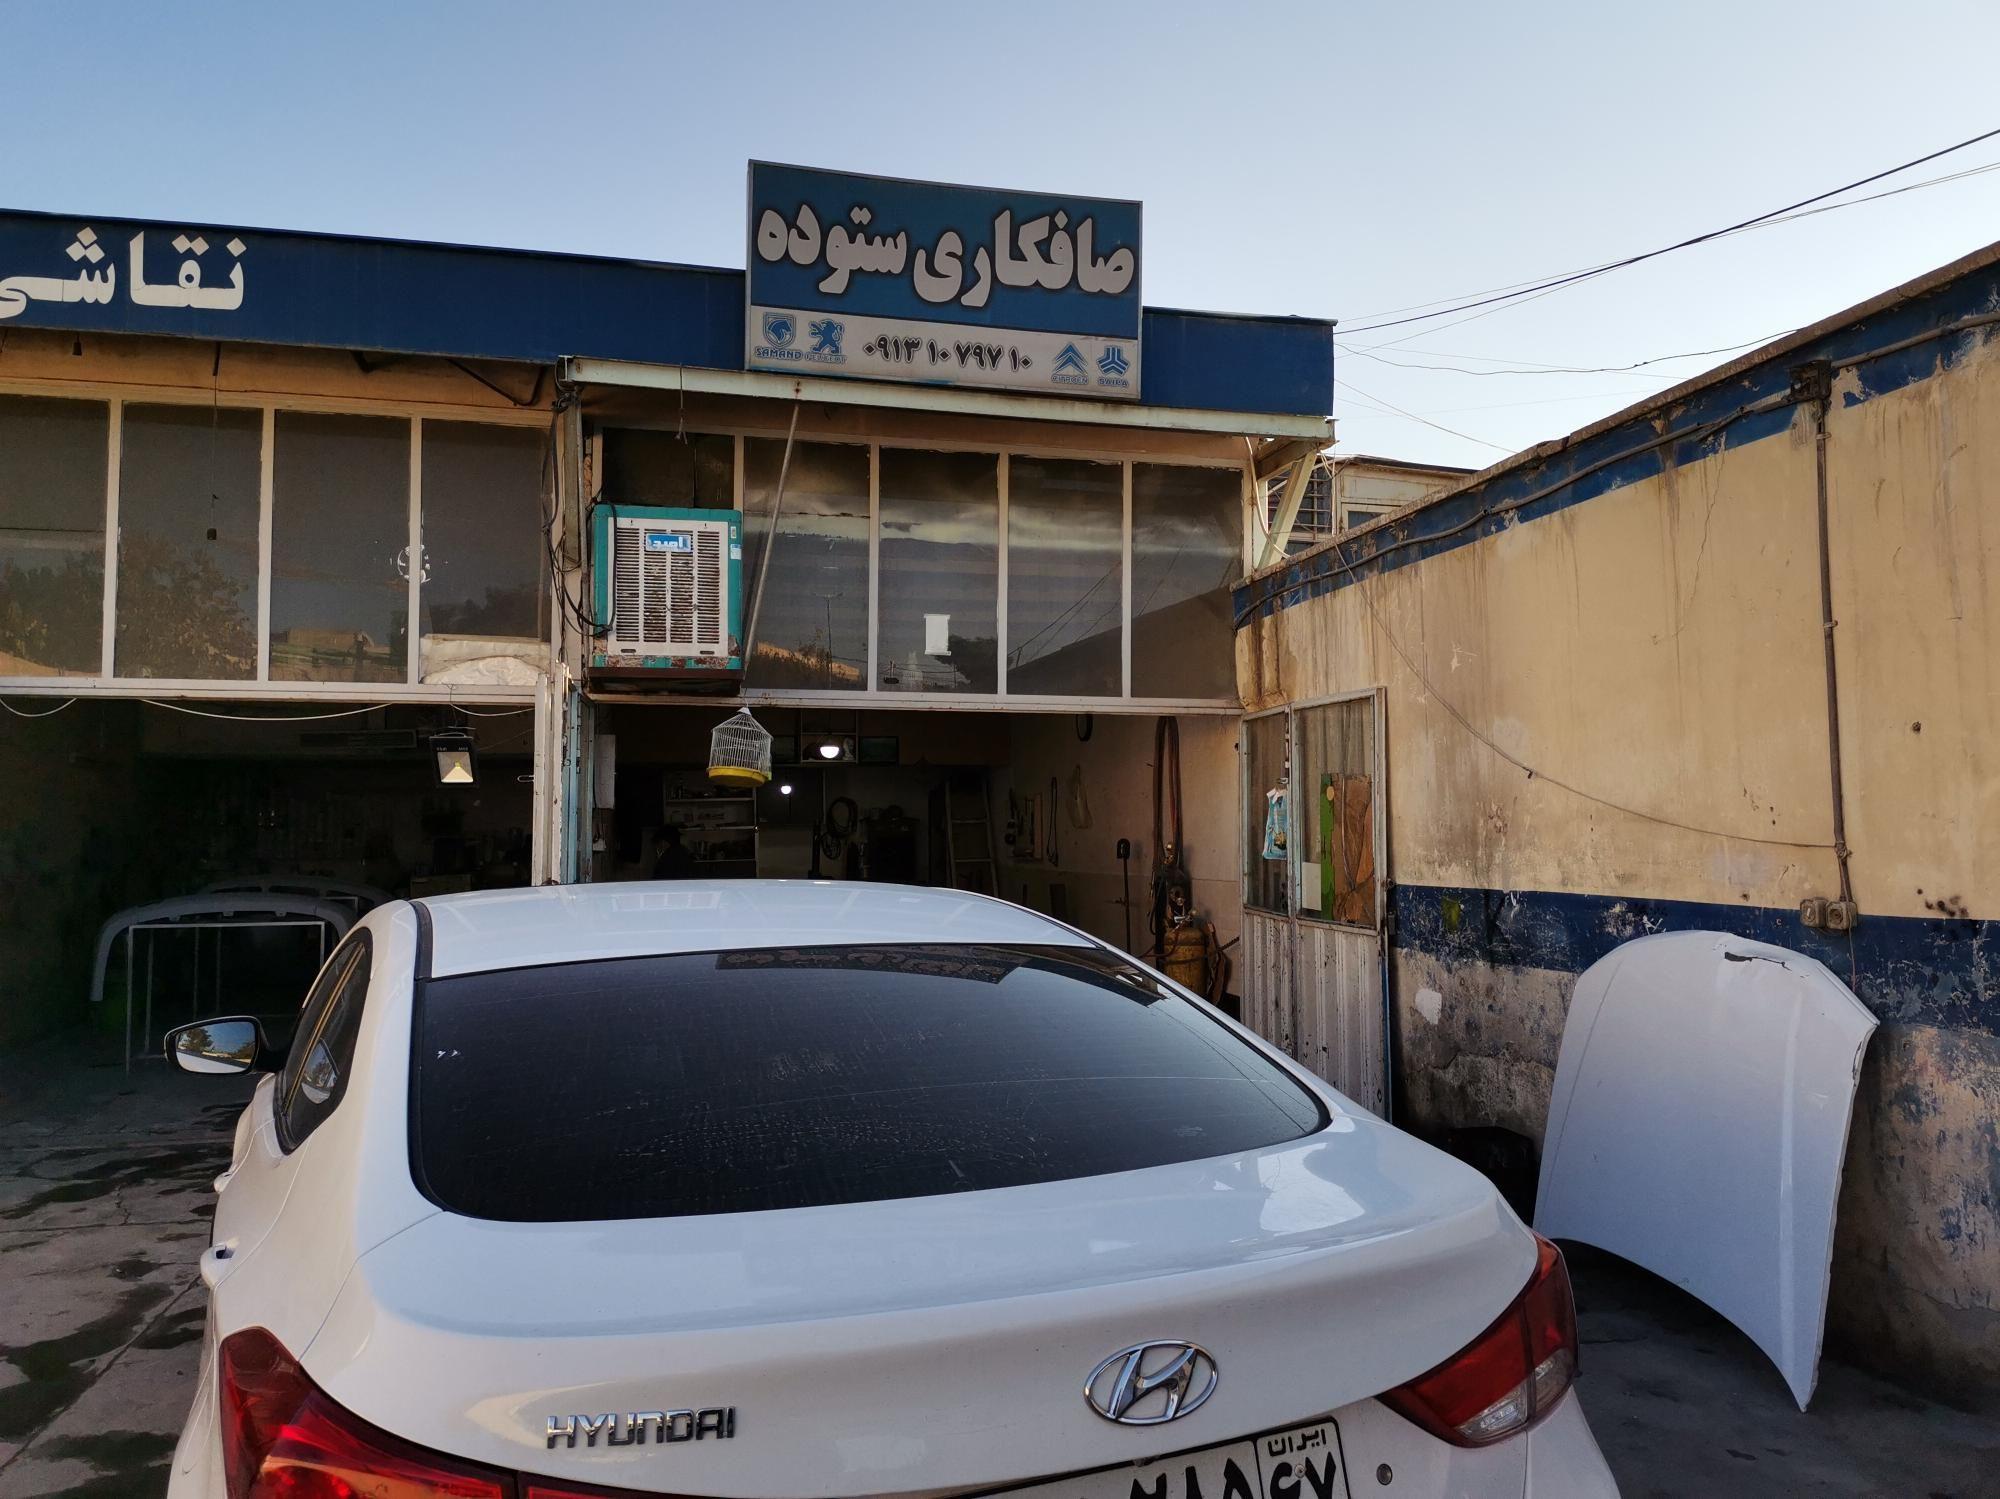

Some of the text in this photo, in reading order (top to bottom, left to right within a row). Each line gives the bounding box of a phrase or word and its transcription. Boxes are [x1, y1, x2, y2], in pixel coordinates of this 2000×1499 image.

[0, 226, 247, 319] نقاشی
[756, 203, 1135, 308] صافکاری ستوده
[755, 346, 802, 361] SAMAND
[546, 1406, 736, 1449] HYUNDAI
[1267, 1428, 1327, 1457] ایران
